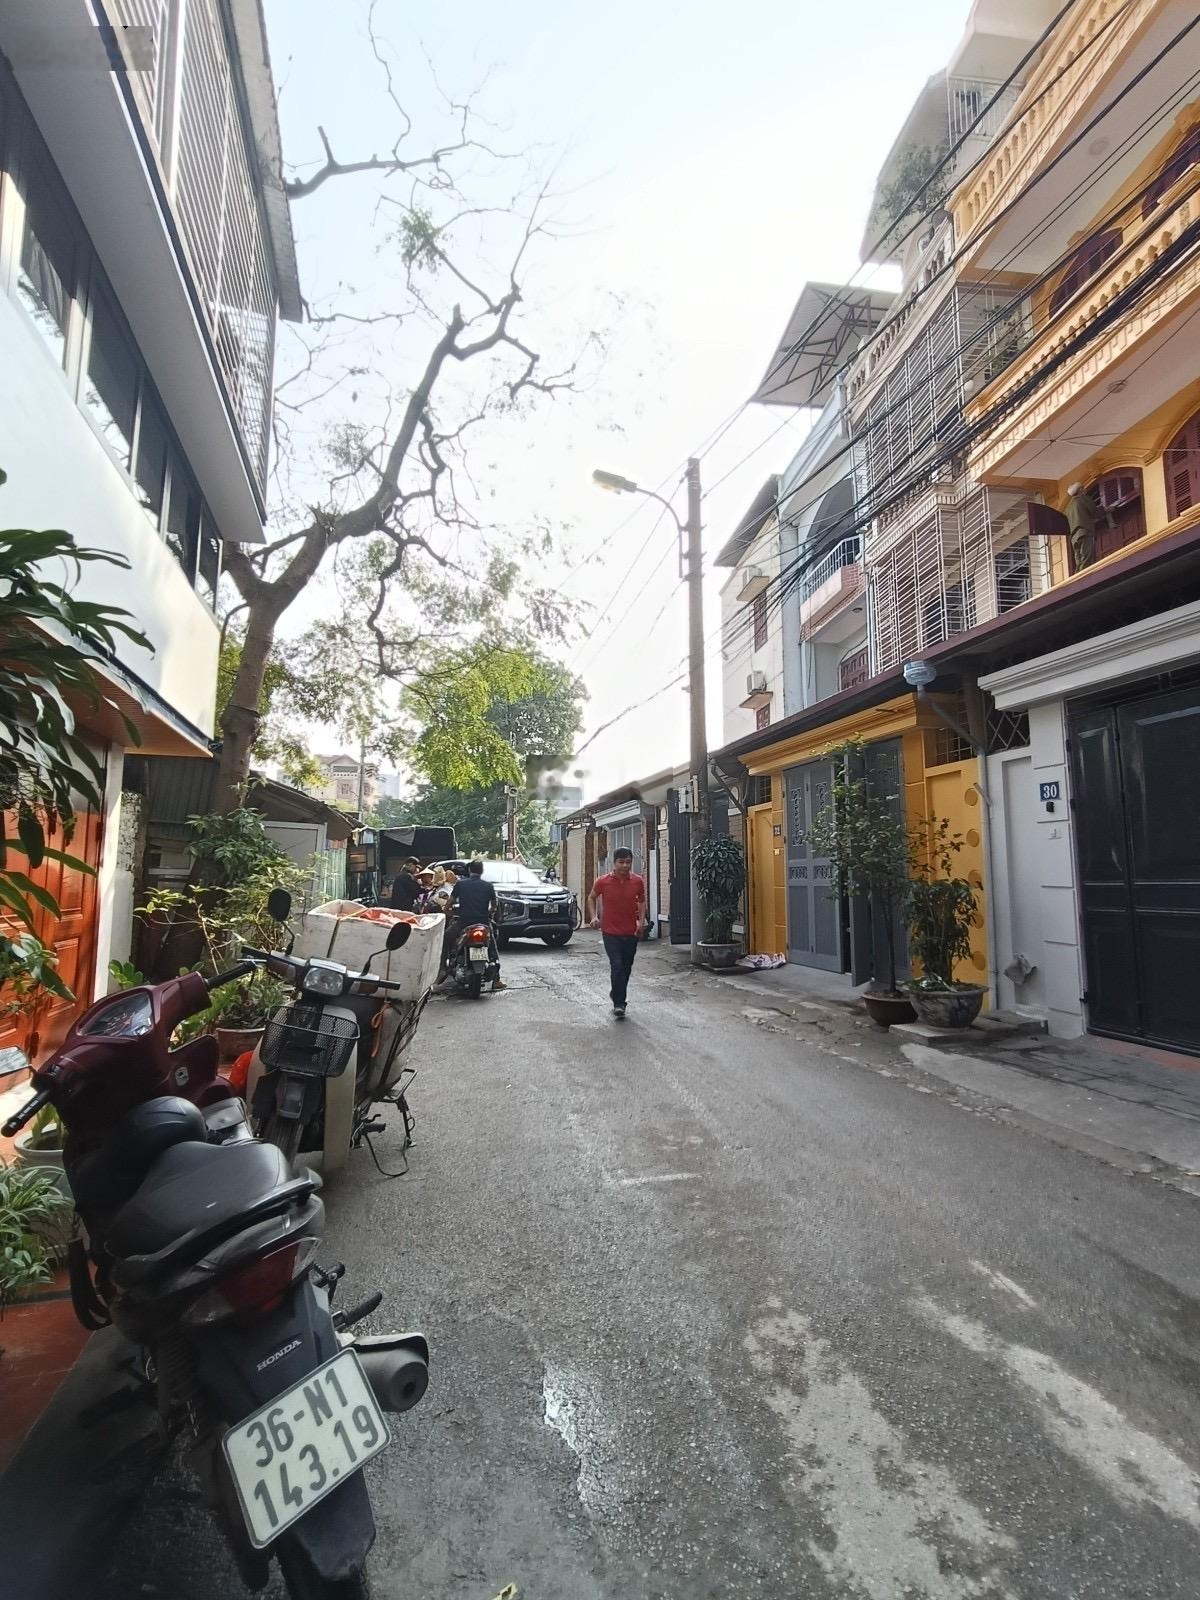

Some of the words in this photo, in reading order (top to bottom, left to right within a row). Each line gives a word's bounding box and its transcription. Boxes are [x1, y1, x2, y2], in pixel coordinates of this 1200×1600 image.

[1043, 784, 1057, 799] 30
[256, 1340, 302, 1371] HONDA
[246, 1368, 348, 1467] 36-N1
[254, 1405, 379, 1527] 143.19
